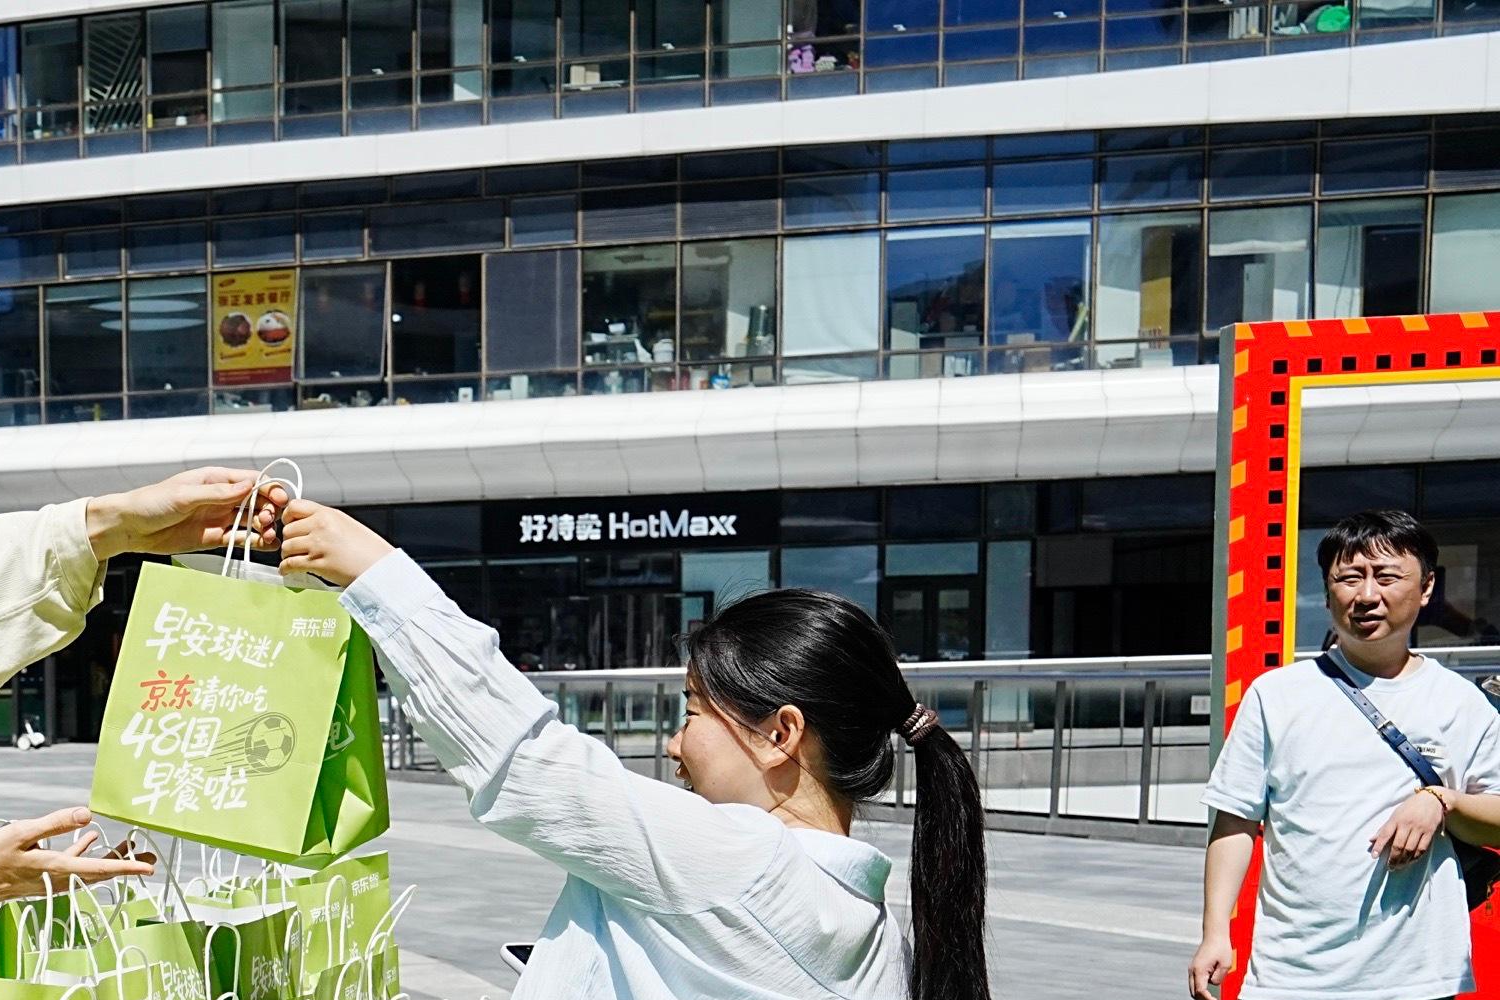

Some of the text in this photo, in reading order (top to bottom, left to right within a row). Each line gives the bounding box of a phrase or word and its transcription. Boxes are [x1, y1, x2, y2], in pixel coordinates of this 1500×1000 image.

[519, 513, 602, 543] 好特卖
[145, 601, 284, 669] 早安球迷!
[139, 669, 269, 714] 京东请你吃
[120, 711, 222, 760] 48国
[131, 760, 249, 816] 早餐啦
